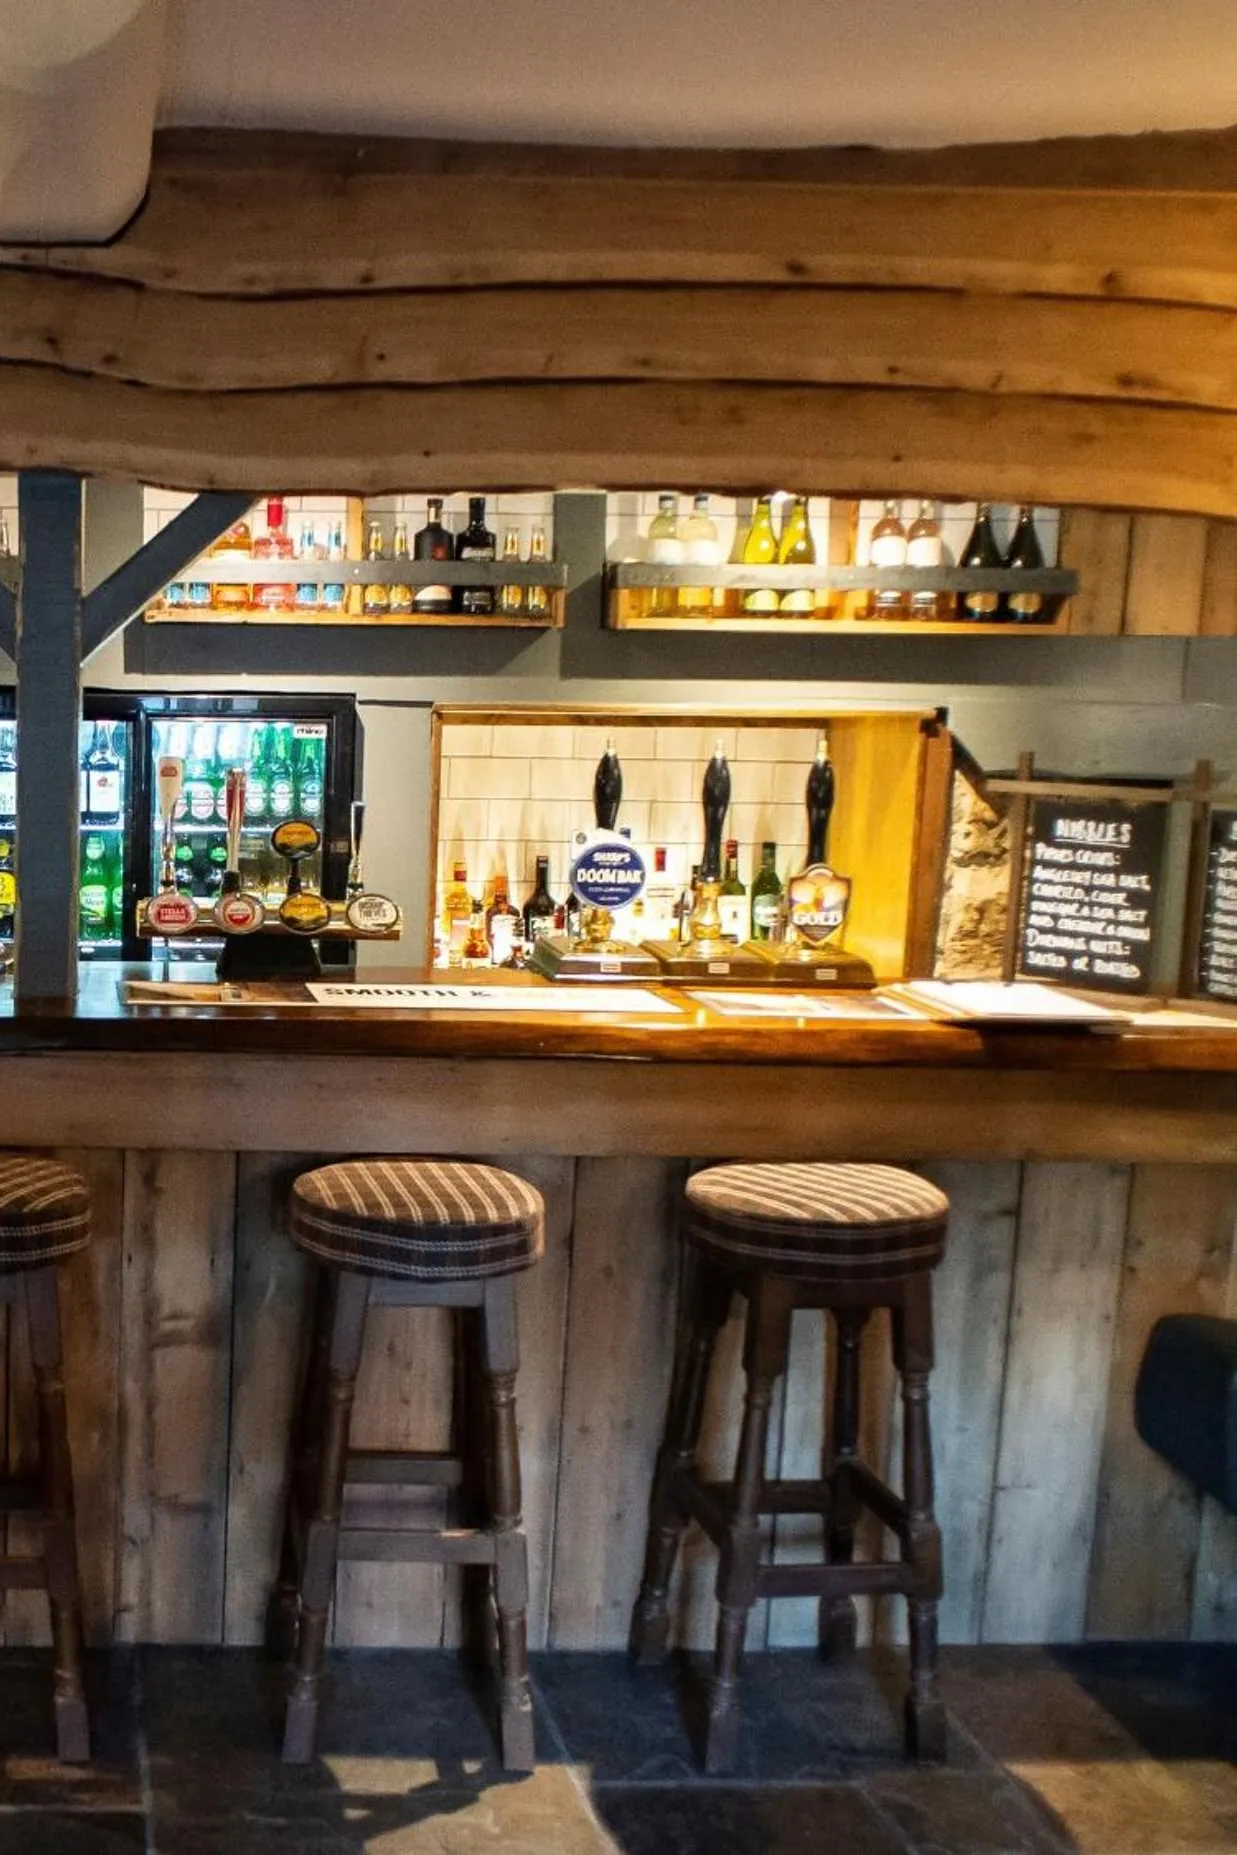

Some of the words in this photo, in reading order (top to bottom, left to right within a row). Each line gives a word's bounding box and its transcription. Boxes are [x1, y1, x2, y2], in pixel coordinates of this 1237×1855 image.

[576, 868, 616, 884] DOOM
[791, 911, 844, 926] GOLD
[324, 988, 460, 997] SMOOTH
